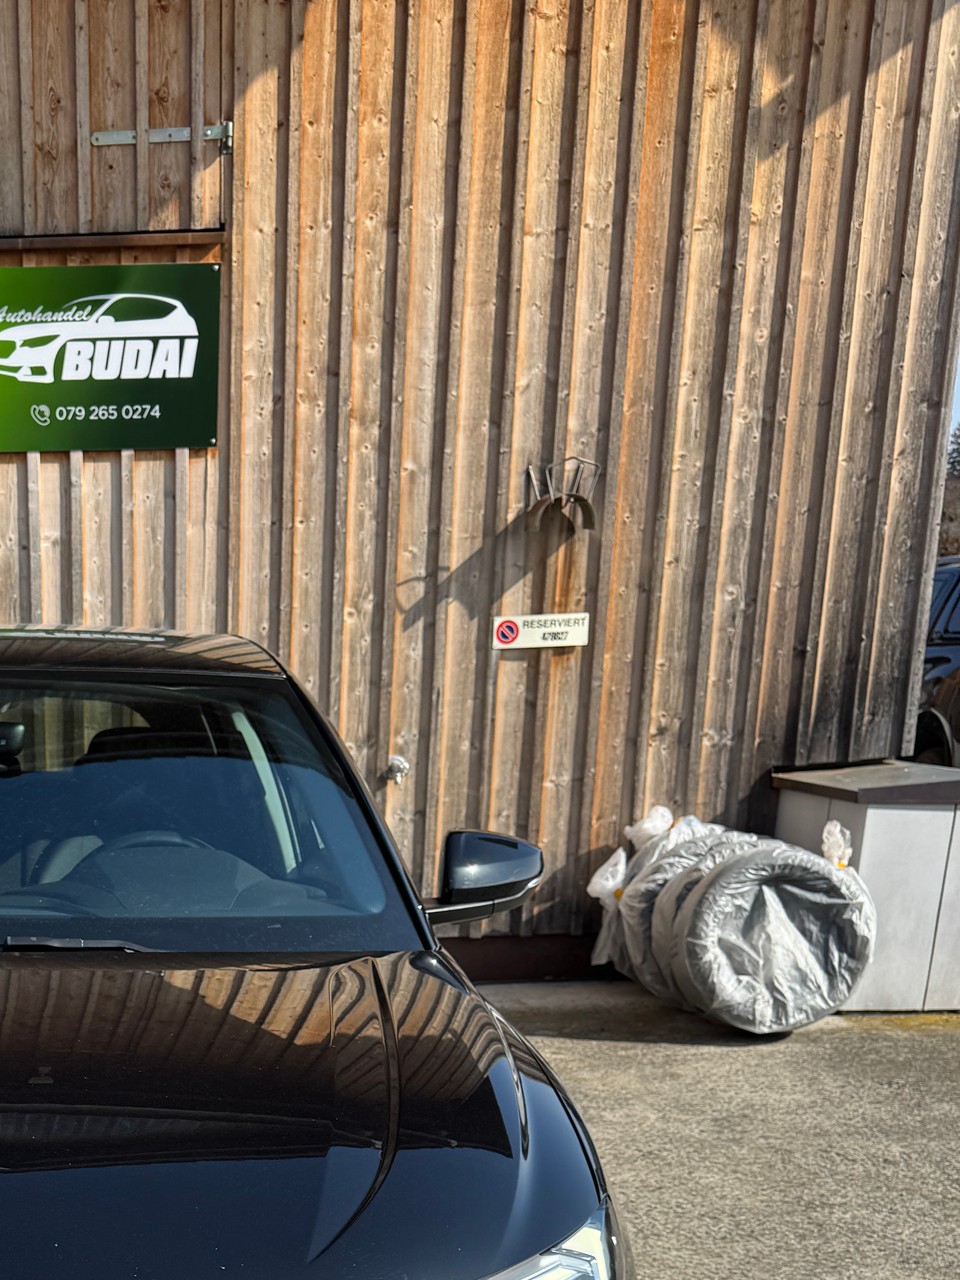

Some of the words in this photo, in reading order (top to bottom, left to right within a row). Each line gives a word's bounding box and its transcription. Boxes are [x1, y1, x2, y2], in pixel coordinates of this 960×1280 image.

[61, 338, 199, 381] BUDAI
[55, 406, 86, 421] 079
[89, 405, 118, 420] 265
[121, 404, 161, 420] 0274
[522, 617, 587, 629] RESERVIERT
